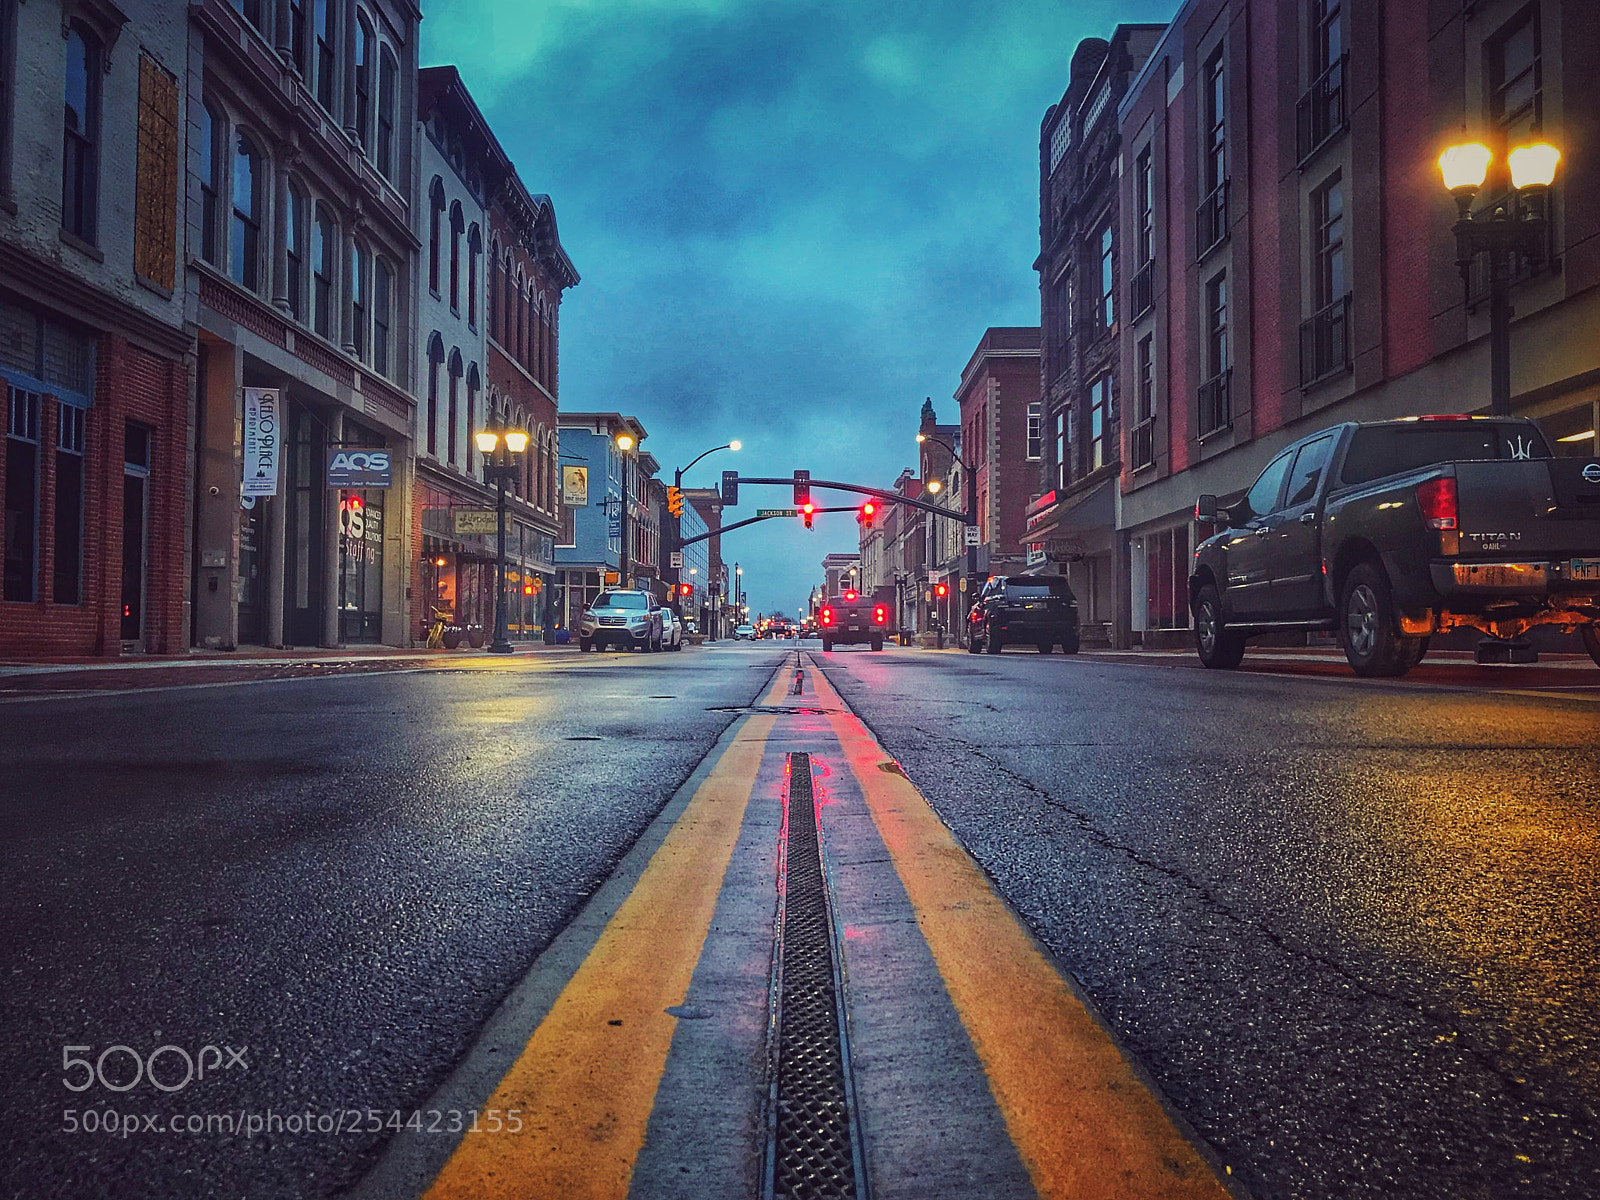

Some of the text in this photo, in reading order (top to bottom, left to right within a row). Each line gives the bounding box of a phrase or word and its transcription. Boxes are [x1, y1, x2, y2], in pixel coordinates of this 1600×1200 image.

[330, 452, 389, 471] AQS
[1469, 532, 1520, 541] TITAN
[346, 538, 375, 564] Staffng
